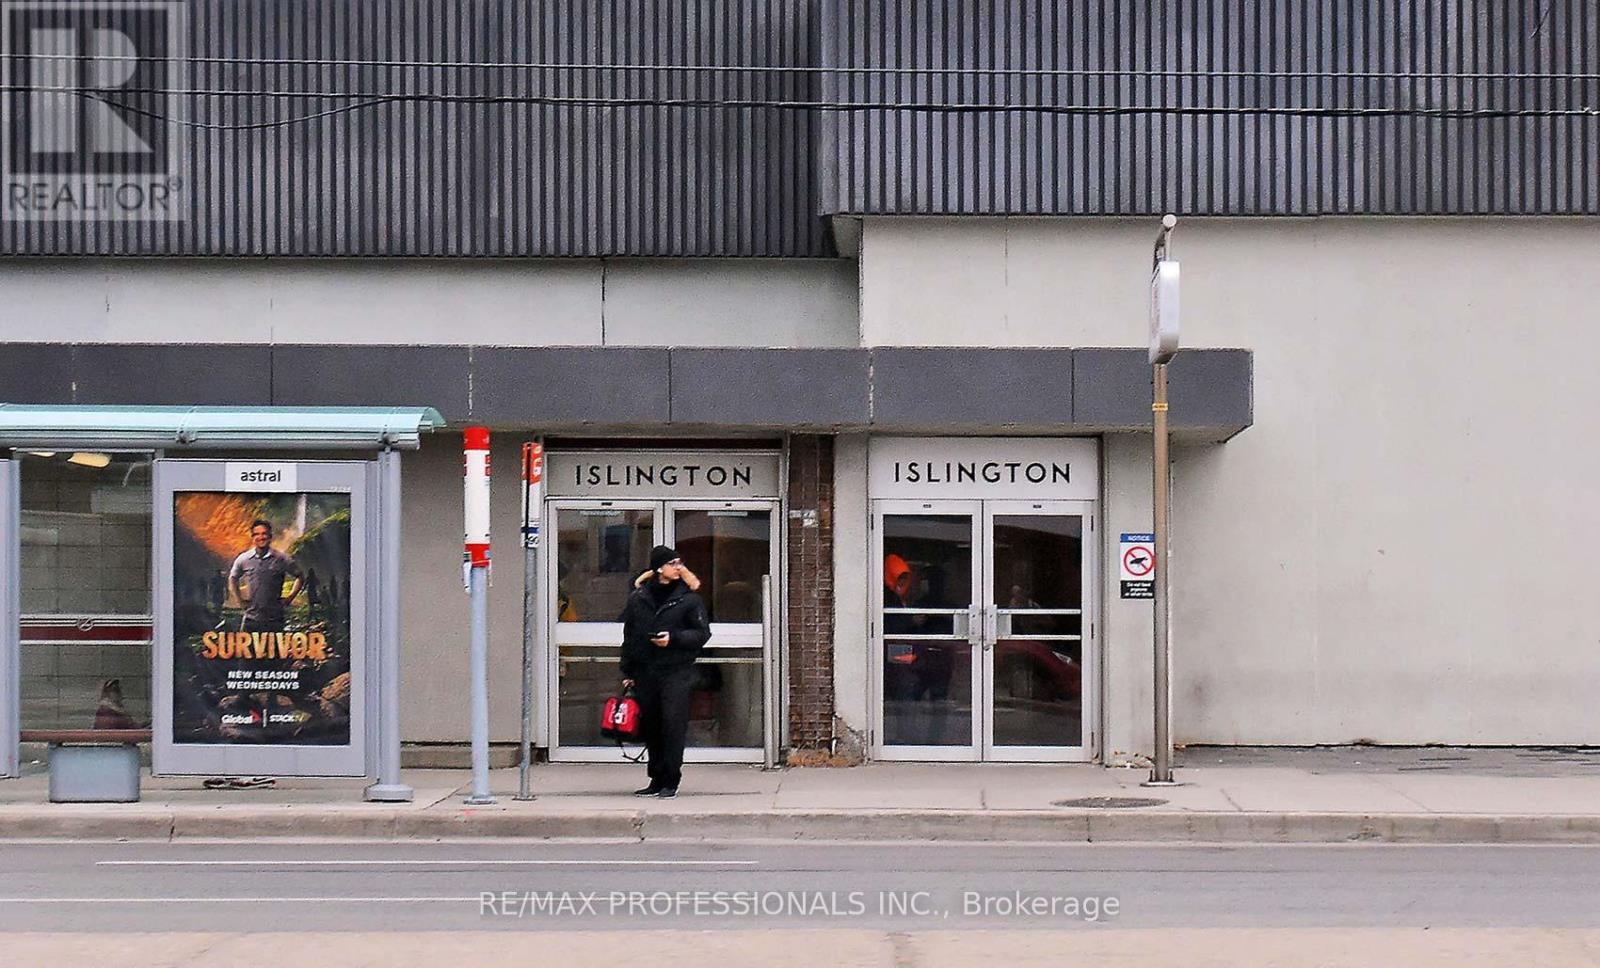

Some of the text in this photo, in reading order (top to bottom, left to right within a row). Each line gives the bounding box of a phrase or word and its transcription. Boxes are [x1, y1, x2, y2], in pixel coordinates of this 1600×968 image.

[240, 470, 281, 482] astral
[576, 465, 750, 486] ISLINGTON
[895, 462, 1071, 483] ISLINGTON
[202, 631, 326, 659] SURVIVOR
[227, 671, 299, 679] NEW SEASON
[226, 681, 300, 690] WEDNESDAYS
[221, 714, 253, 724] Global
